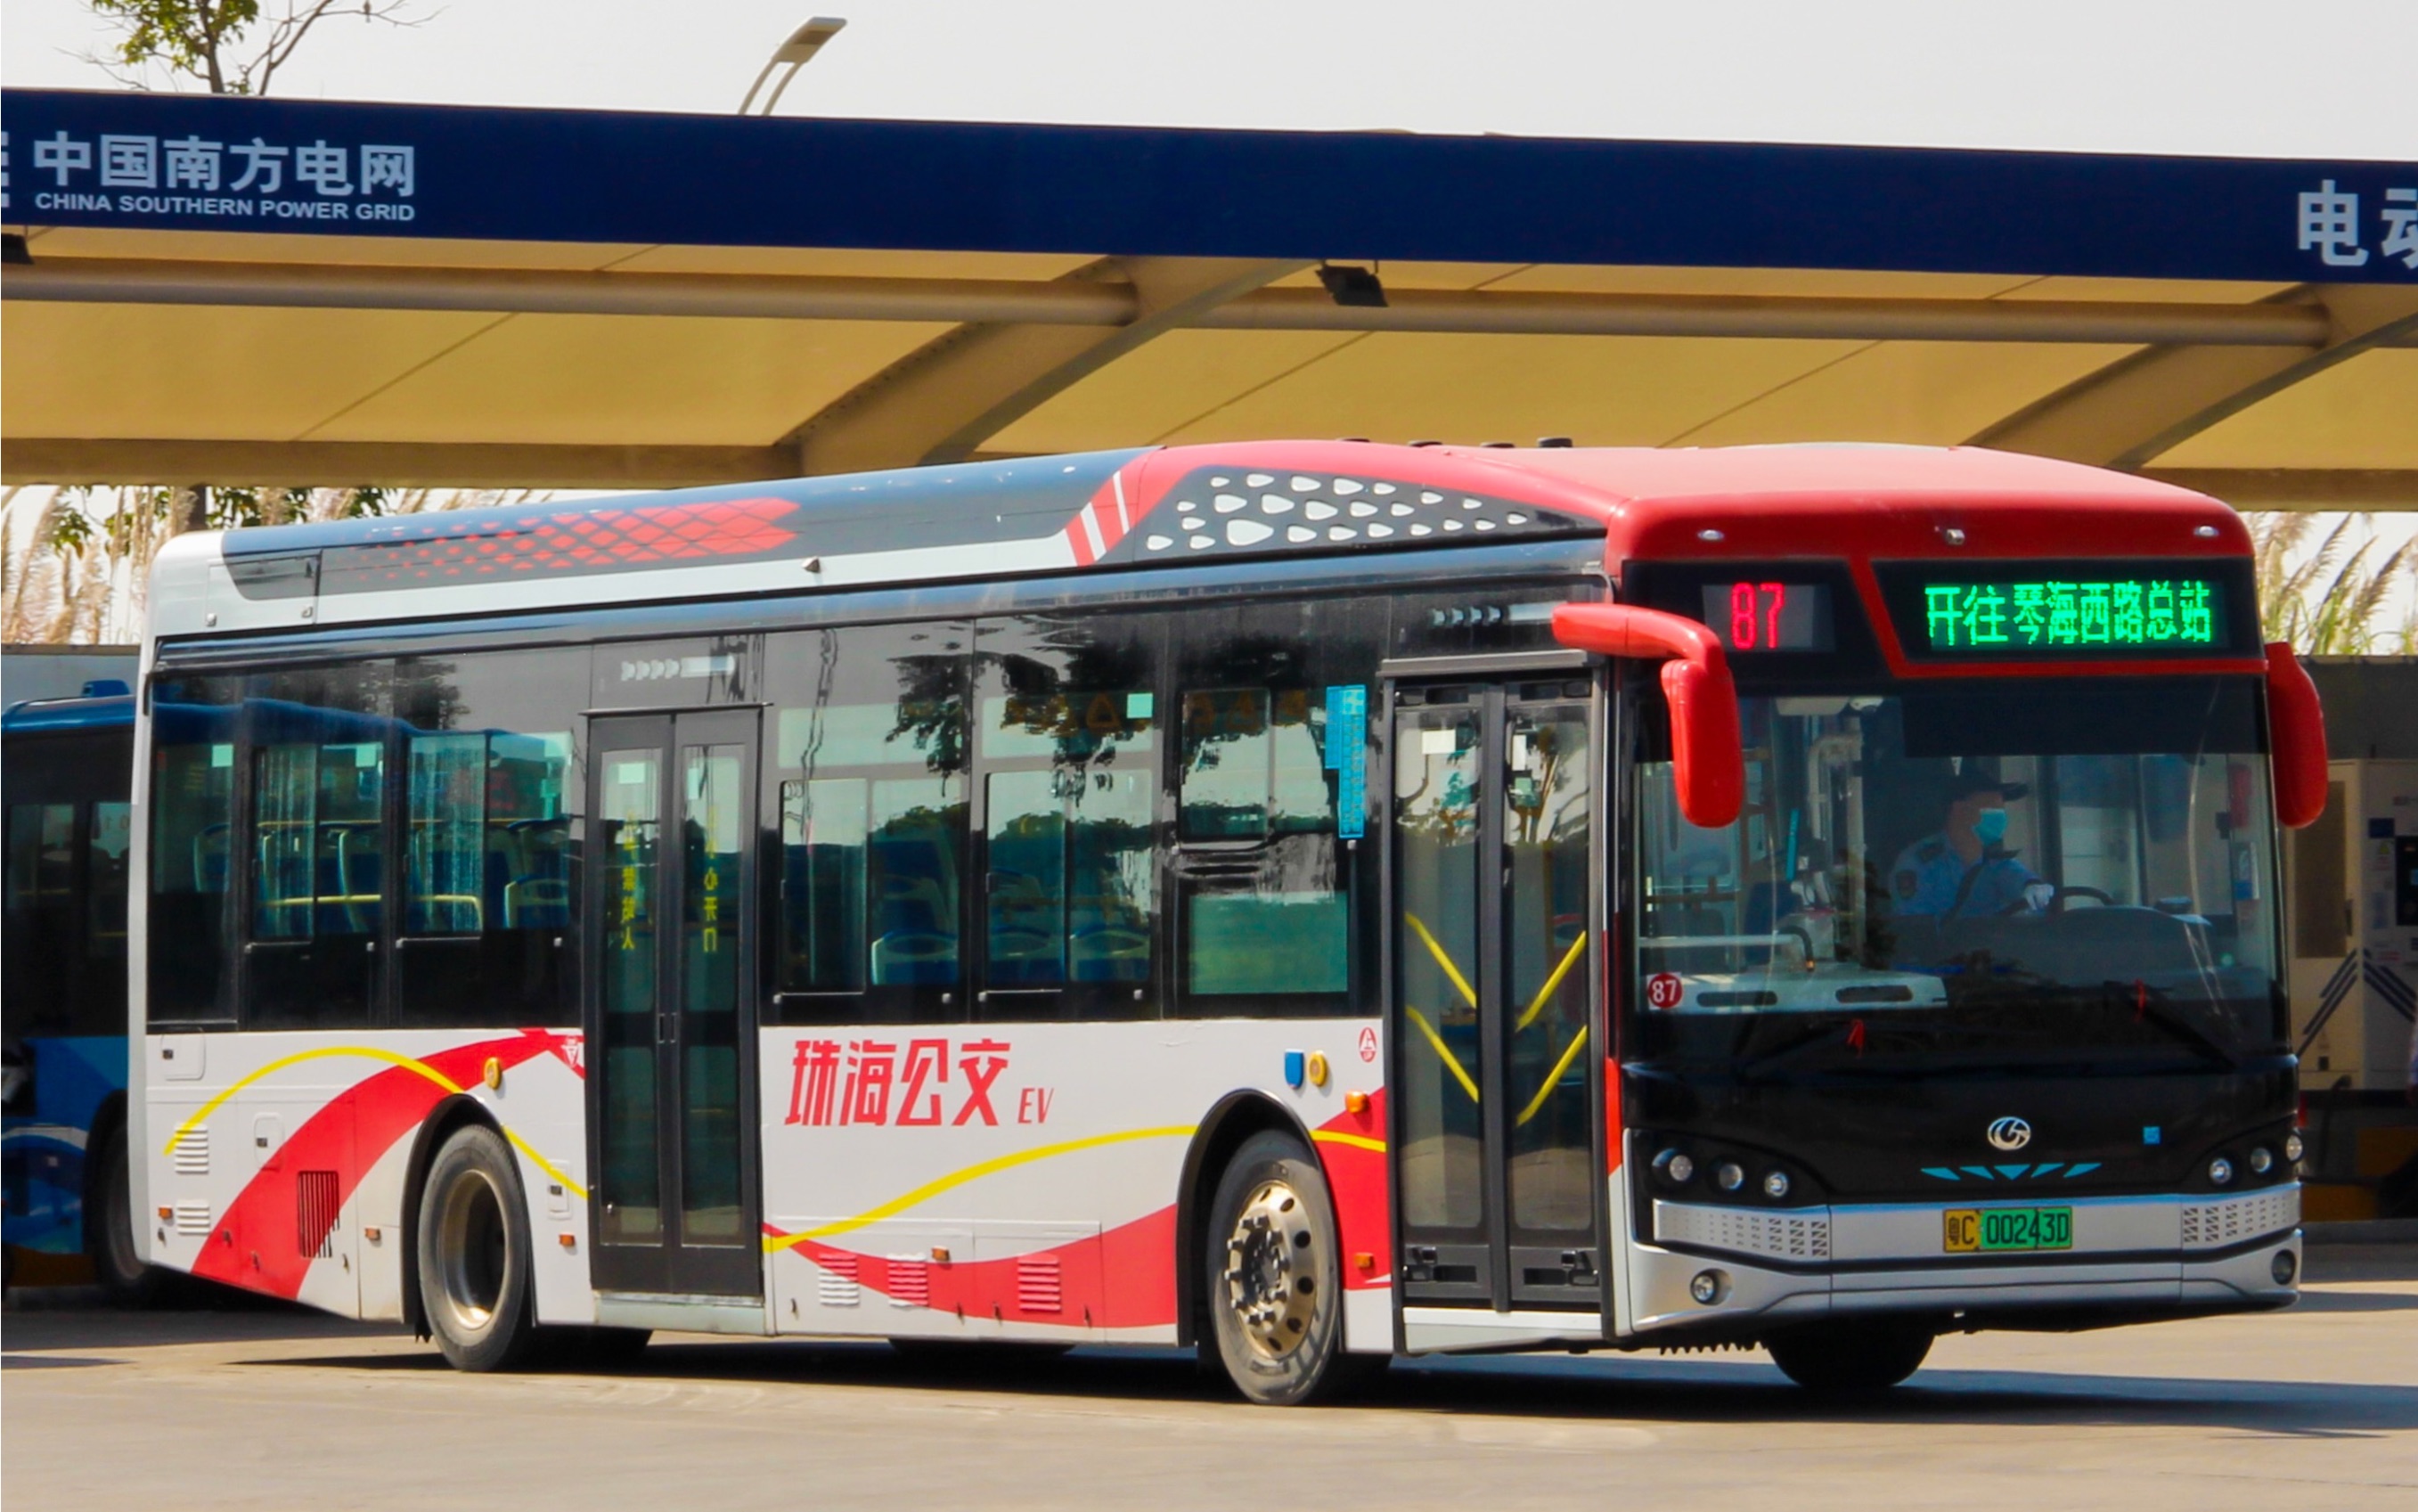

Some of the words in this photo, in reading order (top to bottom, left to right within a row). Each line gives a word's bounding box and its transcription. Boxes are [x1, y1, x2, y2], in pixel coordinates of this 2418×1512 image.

[34, 131, 414, 197] 中国南方电网
[36, 192, 112, 211] CHINA
[118, 194, 253, 216] SOUTHERN
[260, 200, 349, 219] POWER
[355, 203, 415, 221] GRID
[1731, 582, 1785, 650] 87
[1924, 580, 2211, 646] 开往琴海西路总站
[1652, 979, 1677, 1003] 87
[784, 1038, 1010, 1126] 珠海公交
[1017, 1088, 1054, 1124] EV
